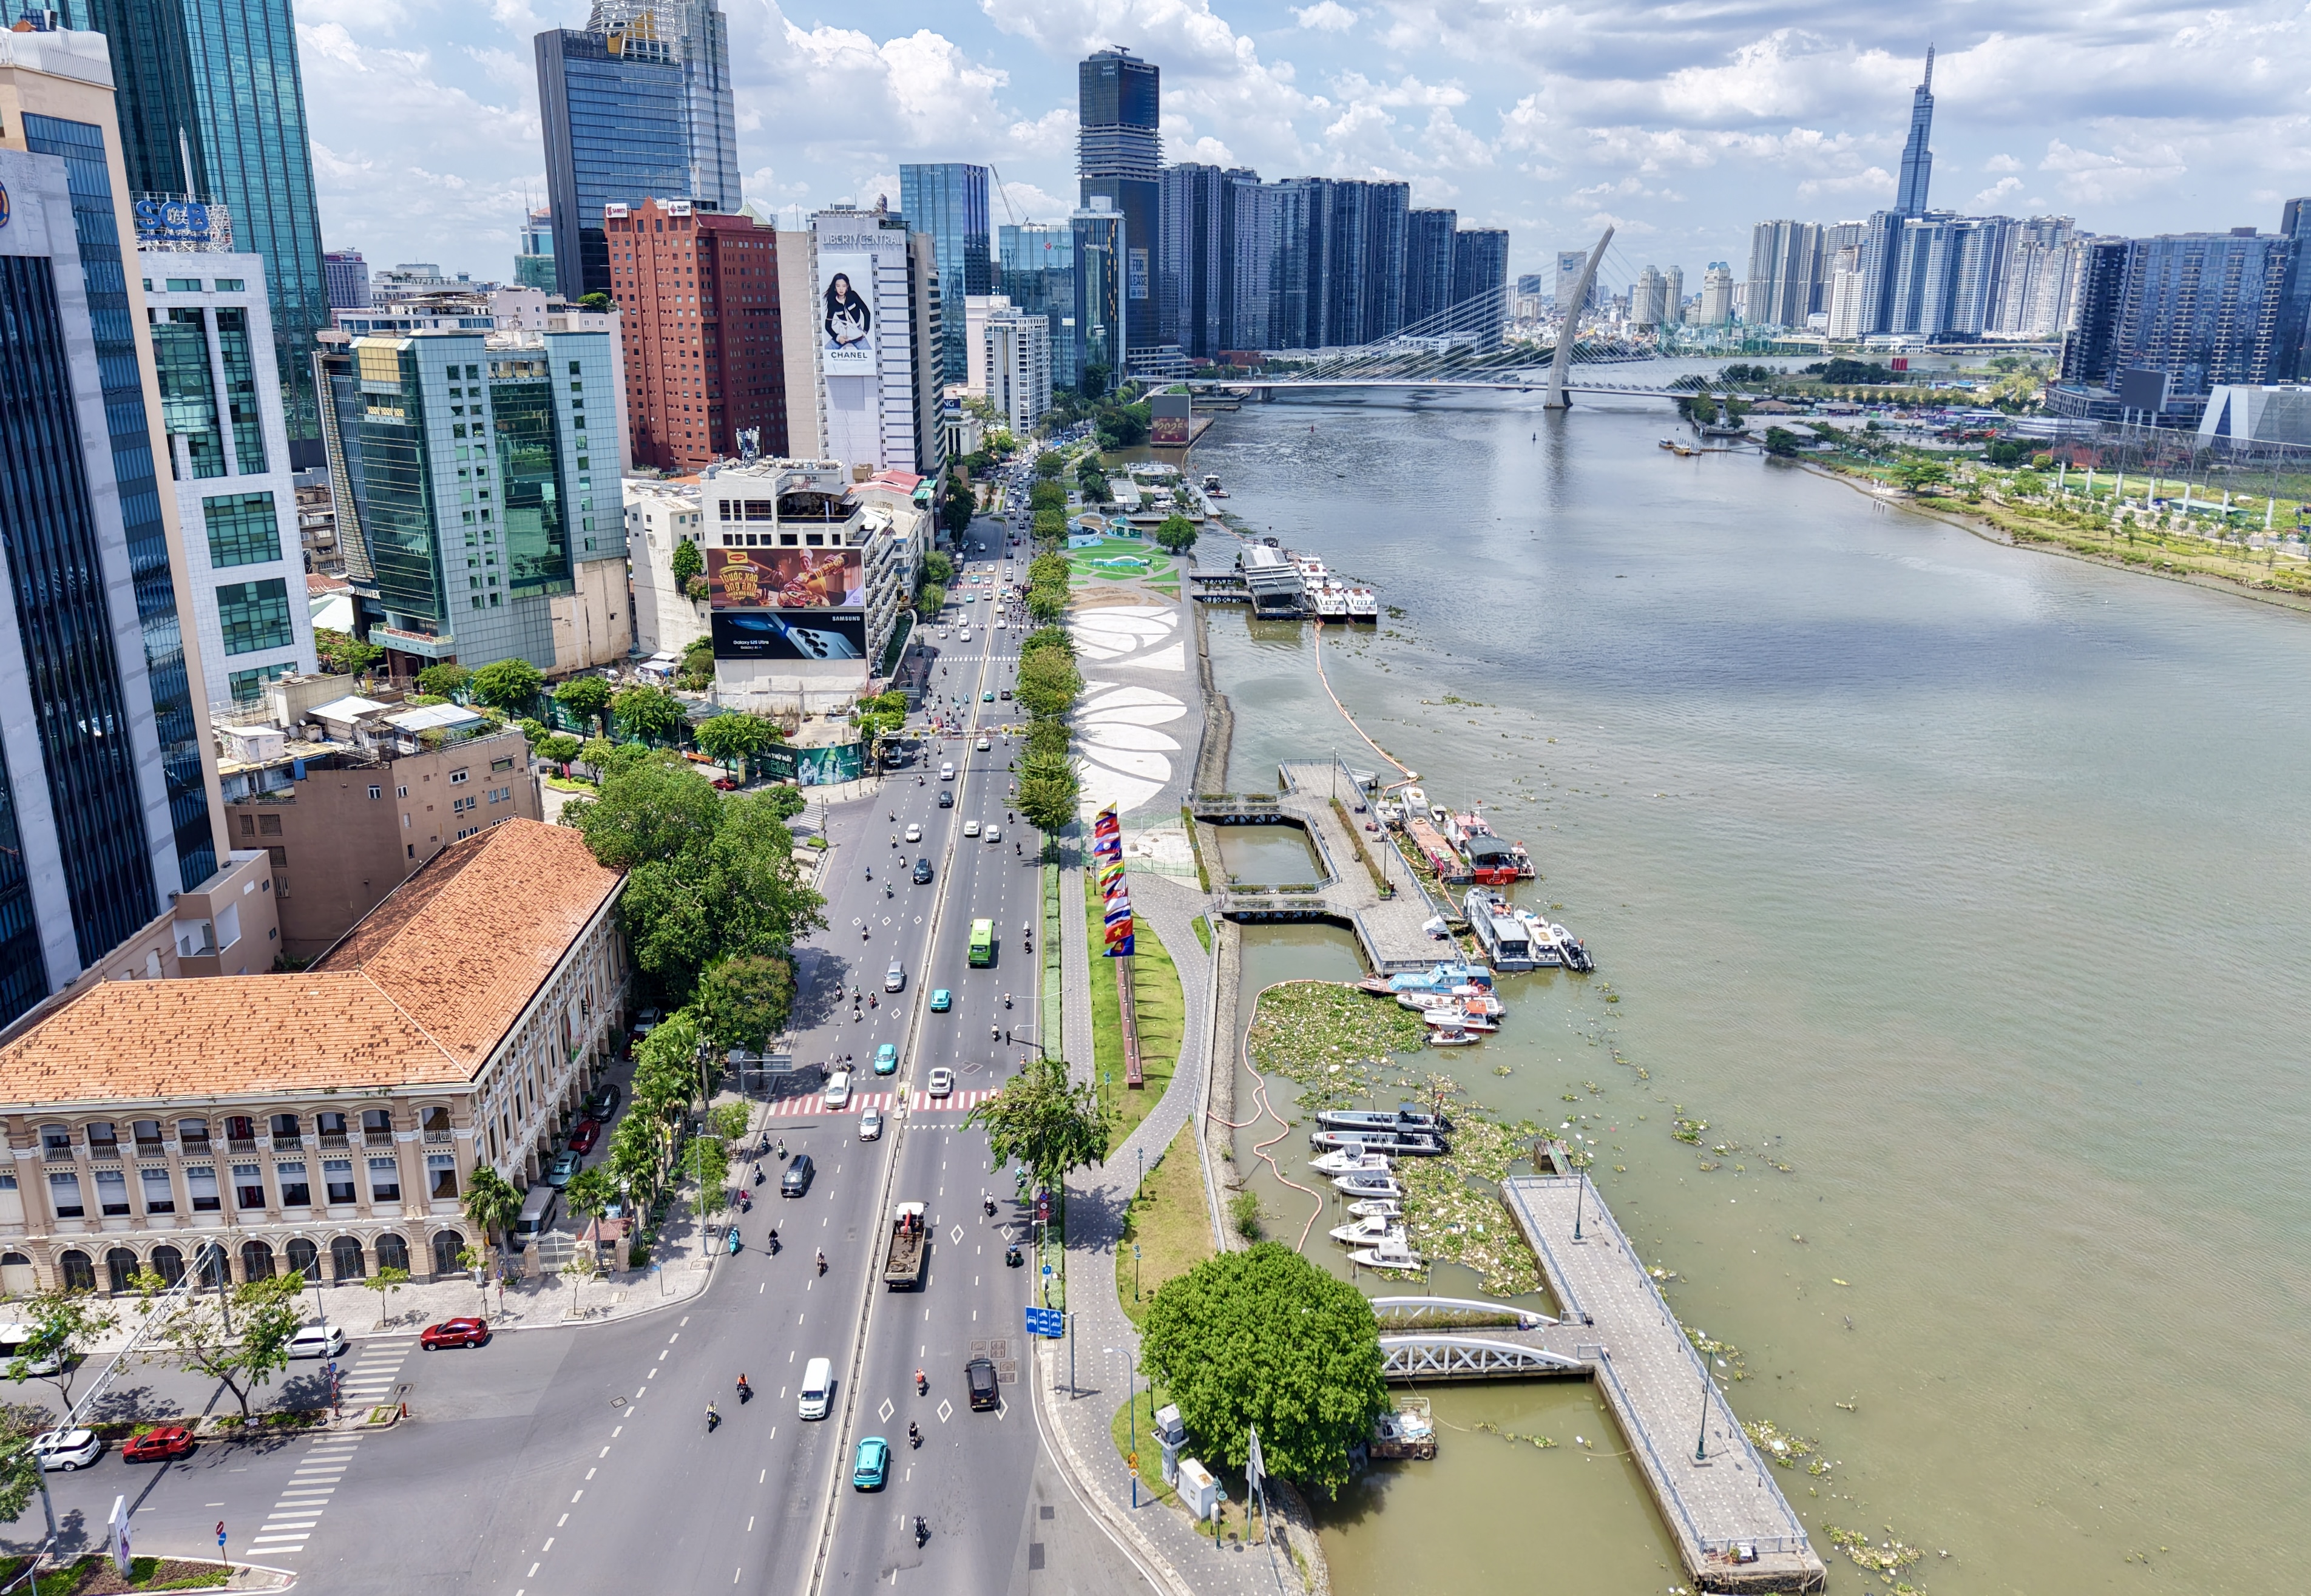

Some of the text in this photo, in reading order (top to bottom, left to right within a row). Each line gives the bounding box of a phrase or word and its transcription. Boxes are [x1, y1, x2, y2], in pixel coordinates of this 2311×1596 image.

[136, 200, 209, 231] SCB
[823, 234, 902, 245] LIBERTY CENTRAL
[1133, 259, 1143, 271] FOR
[1130, 275, 1147, 286] LEASE
